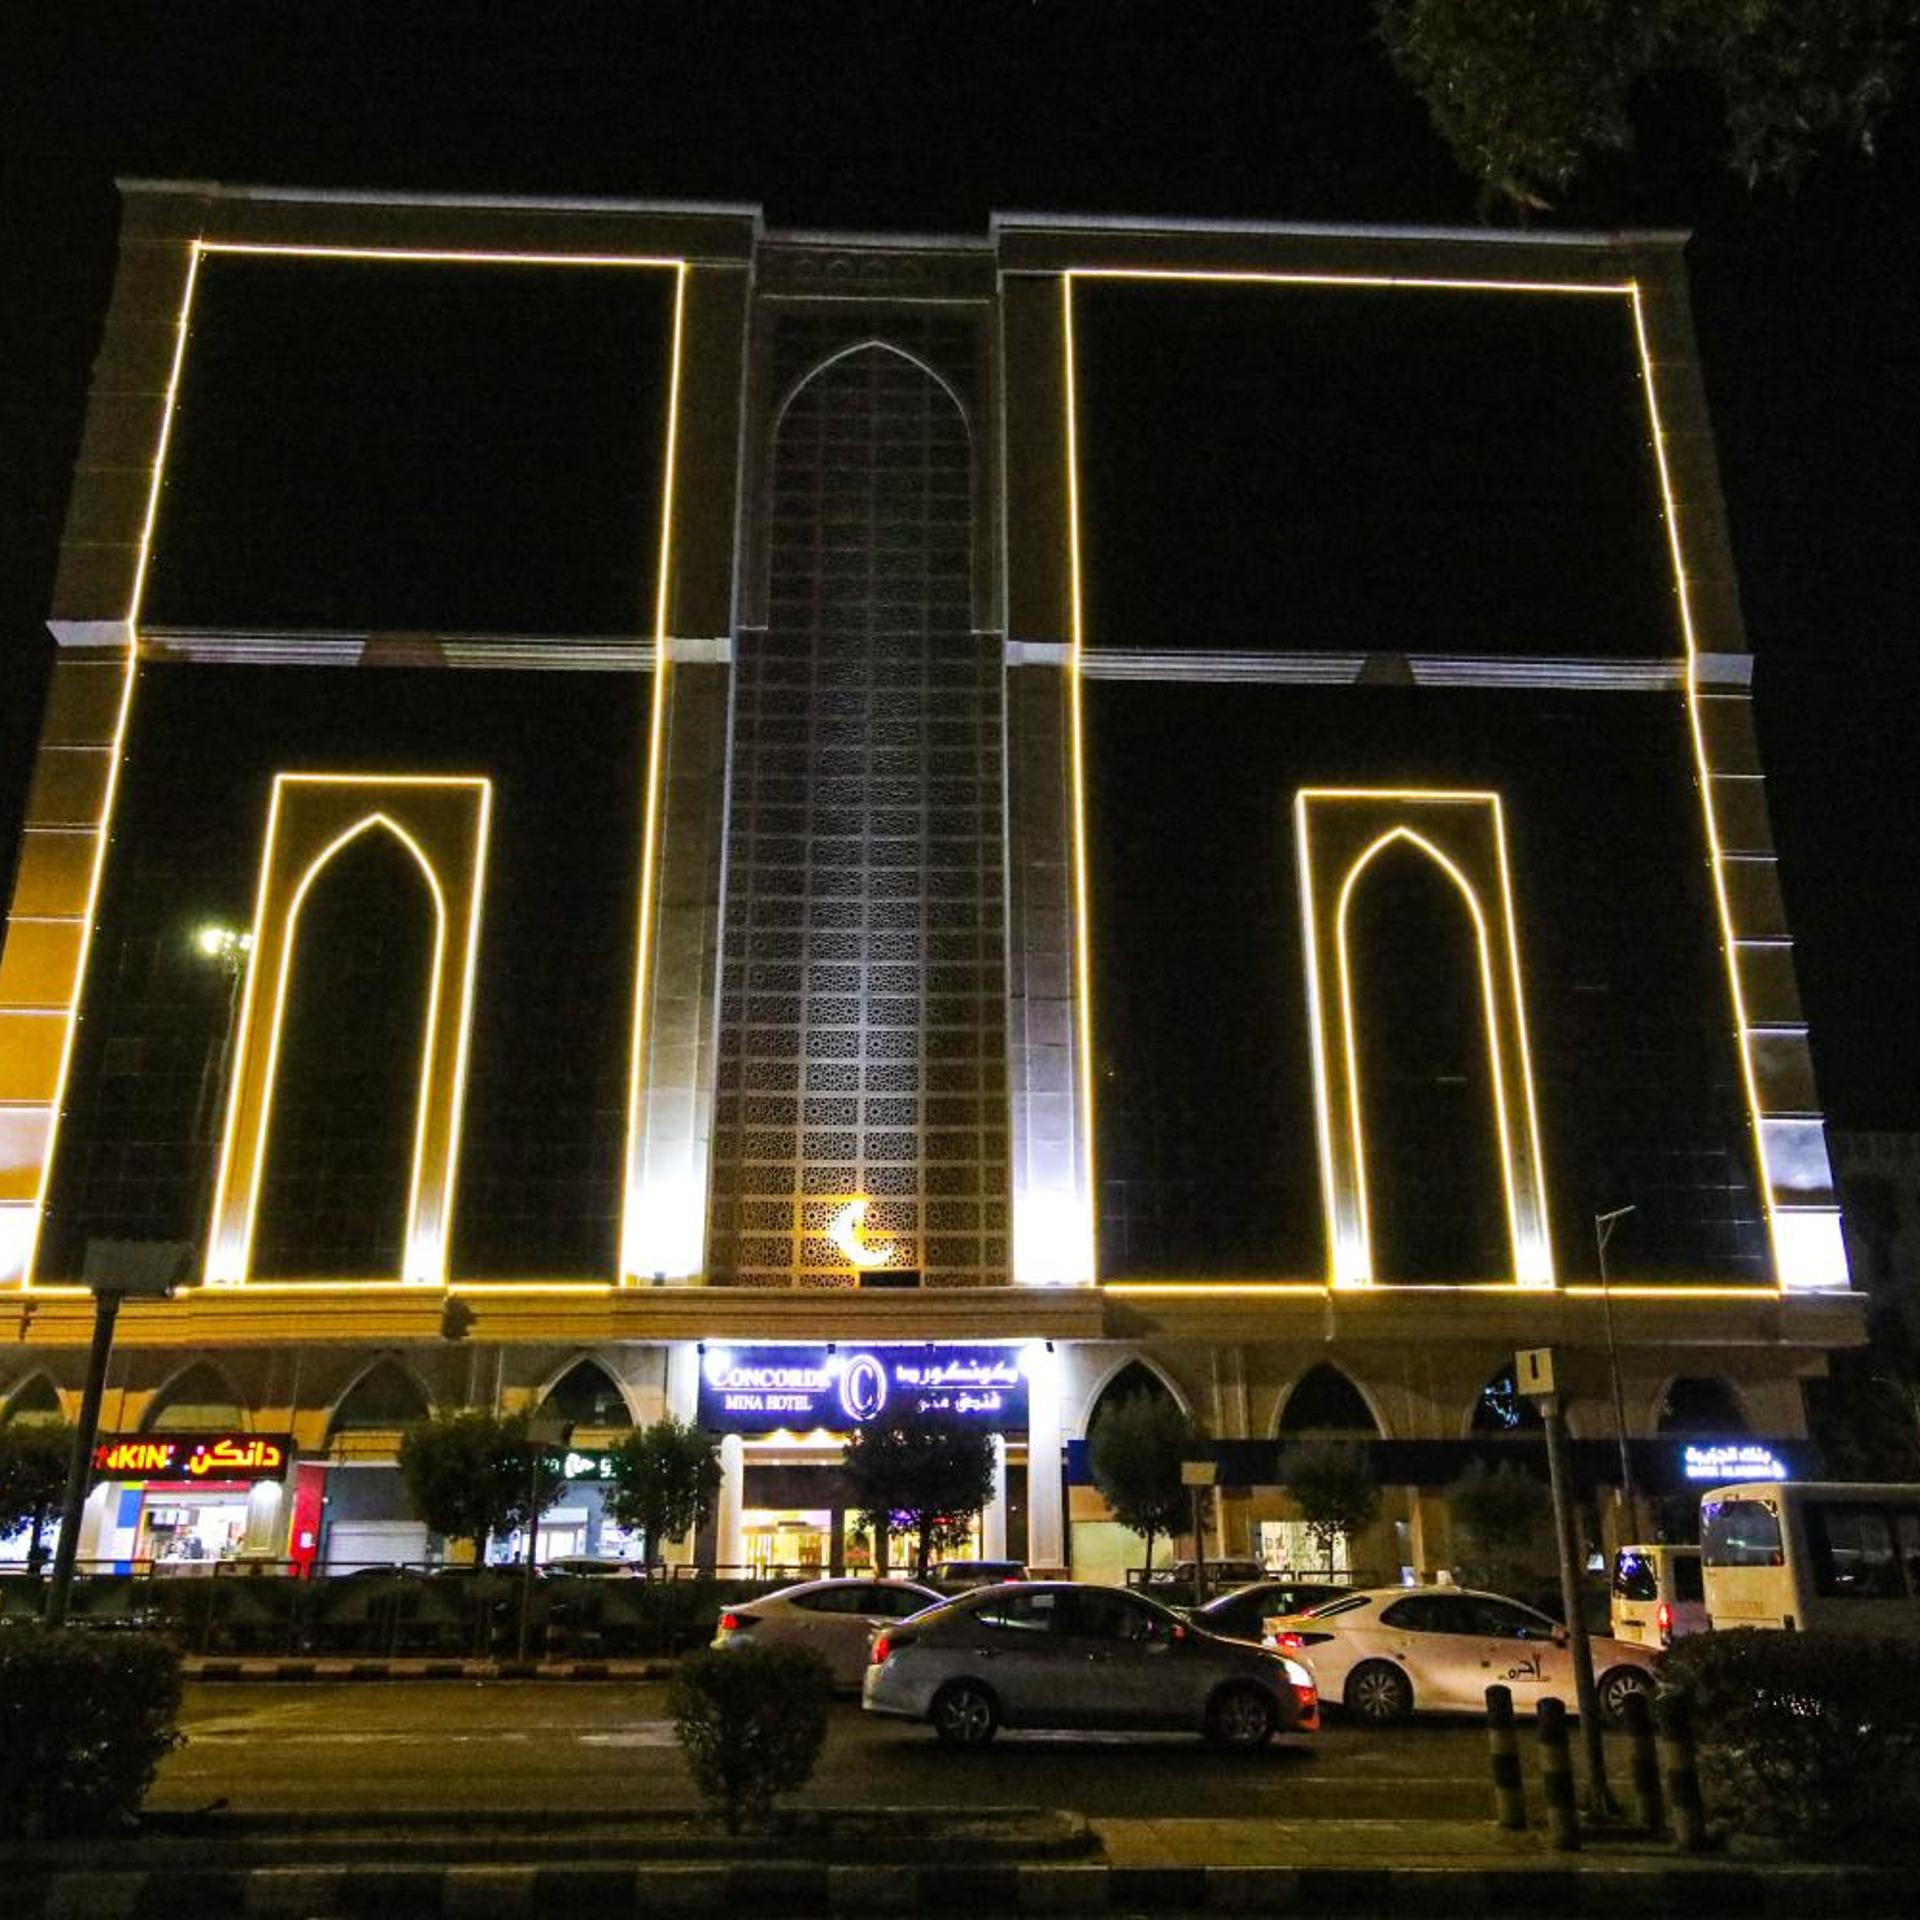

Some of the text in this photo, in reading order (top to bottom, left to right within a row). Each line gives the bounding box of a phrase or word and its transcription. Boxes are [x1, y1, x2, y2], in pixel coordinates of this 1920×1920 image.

[725, 1394, 813, 1410] MINA HOTEL
[190, 1440, 280, 1474] دانكن
